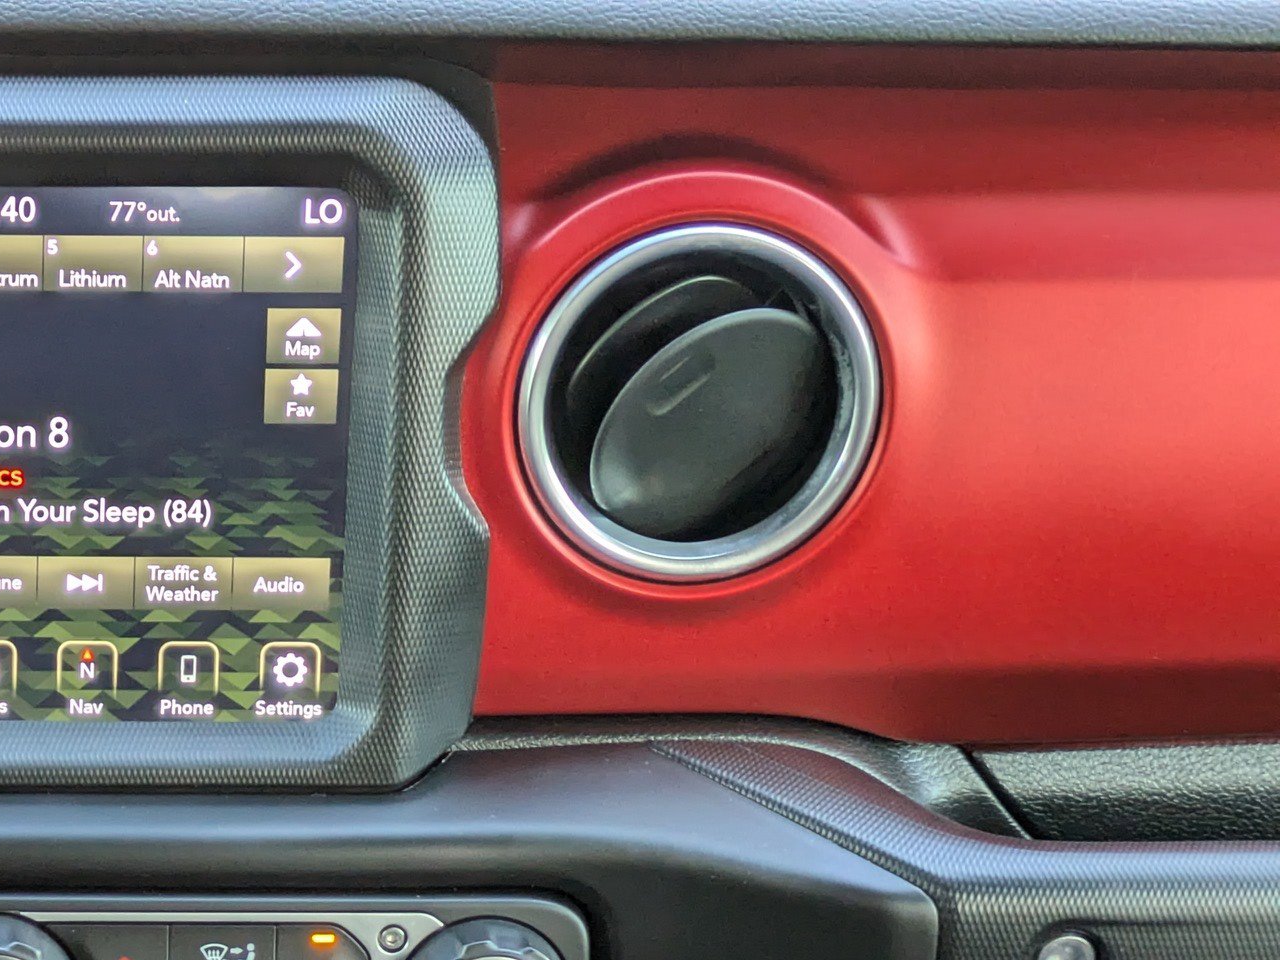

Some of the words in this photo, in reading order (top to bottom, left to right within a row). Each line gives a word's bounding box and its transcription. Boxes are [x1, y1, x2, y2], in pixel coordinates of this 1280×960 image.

[304, 198, 343, 224] LO
[47, 240, 58, 255] 5
[146, 240, 158, 256] 6
[59, 269, 127, 288] Lithium
[154, 270, 181, 288] Alt
[185, 271, 230, 288] Natn
[285, 341, 320, 359] Map
[286, 402, 315, 418] Fav
[48, 417, 70, 448] 8
[18, 498, 76, 523] Your
[83, 498, 155, 528] Sleep
[164, 499, 212, 527] (84)
[148, 565, 199, 581] Traffic
[203, 565, 217, 581] &
[253, 576, 304, 593] Audio
[146, 586, 219, 602] Weather
[79, 663, 95, 679] N
[70, 699, 103, 715] Nav
[160, 699, 214, 715] Phone
[255, 700, 322, 718] Settings
